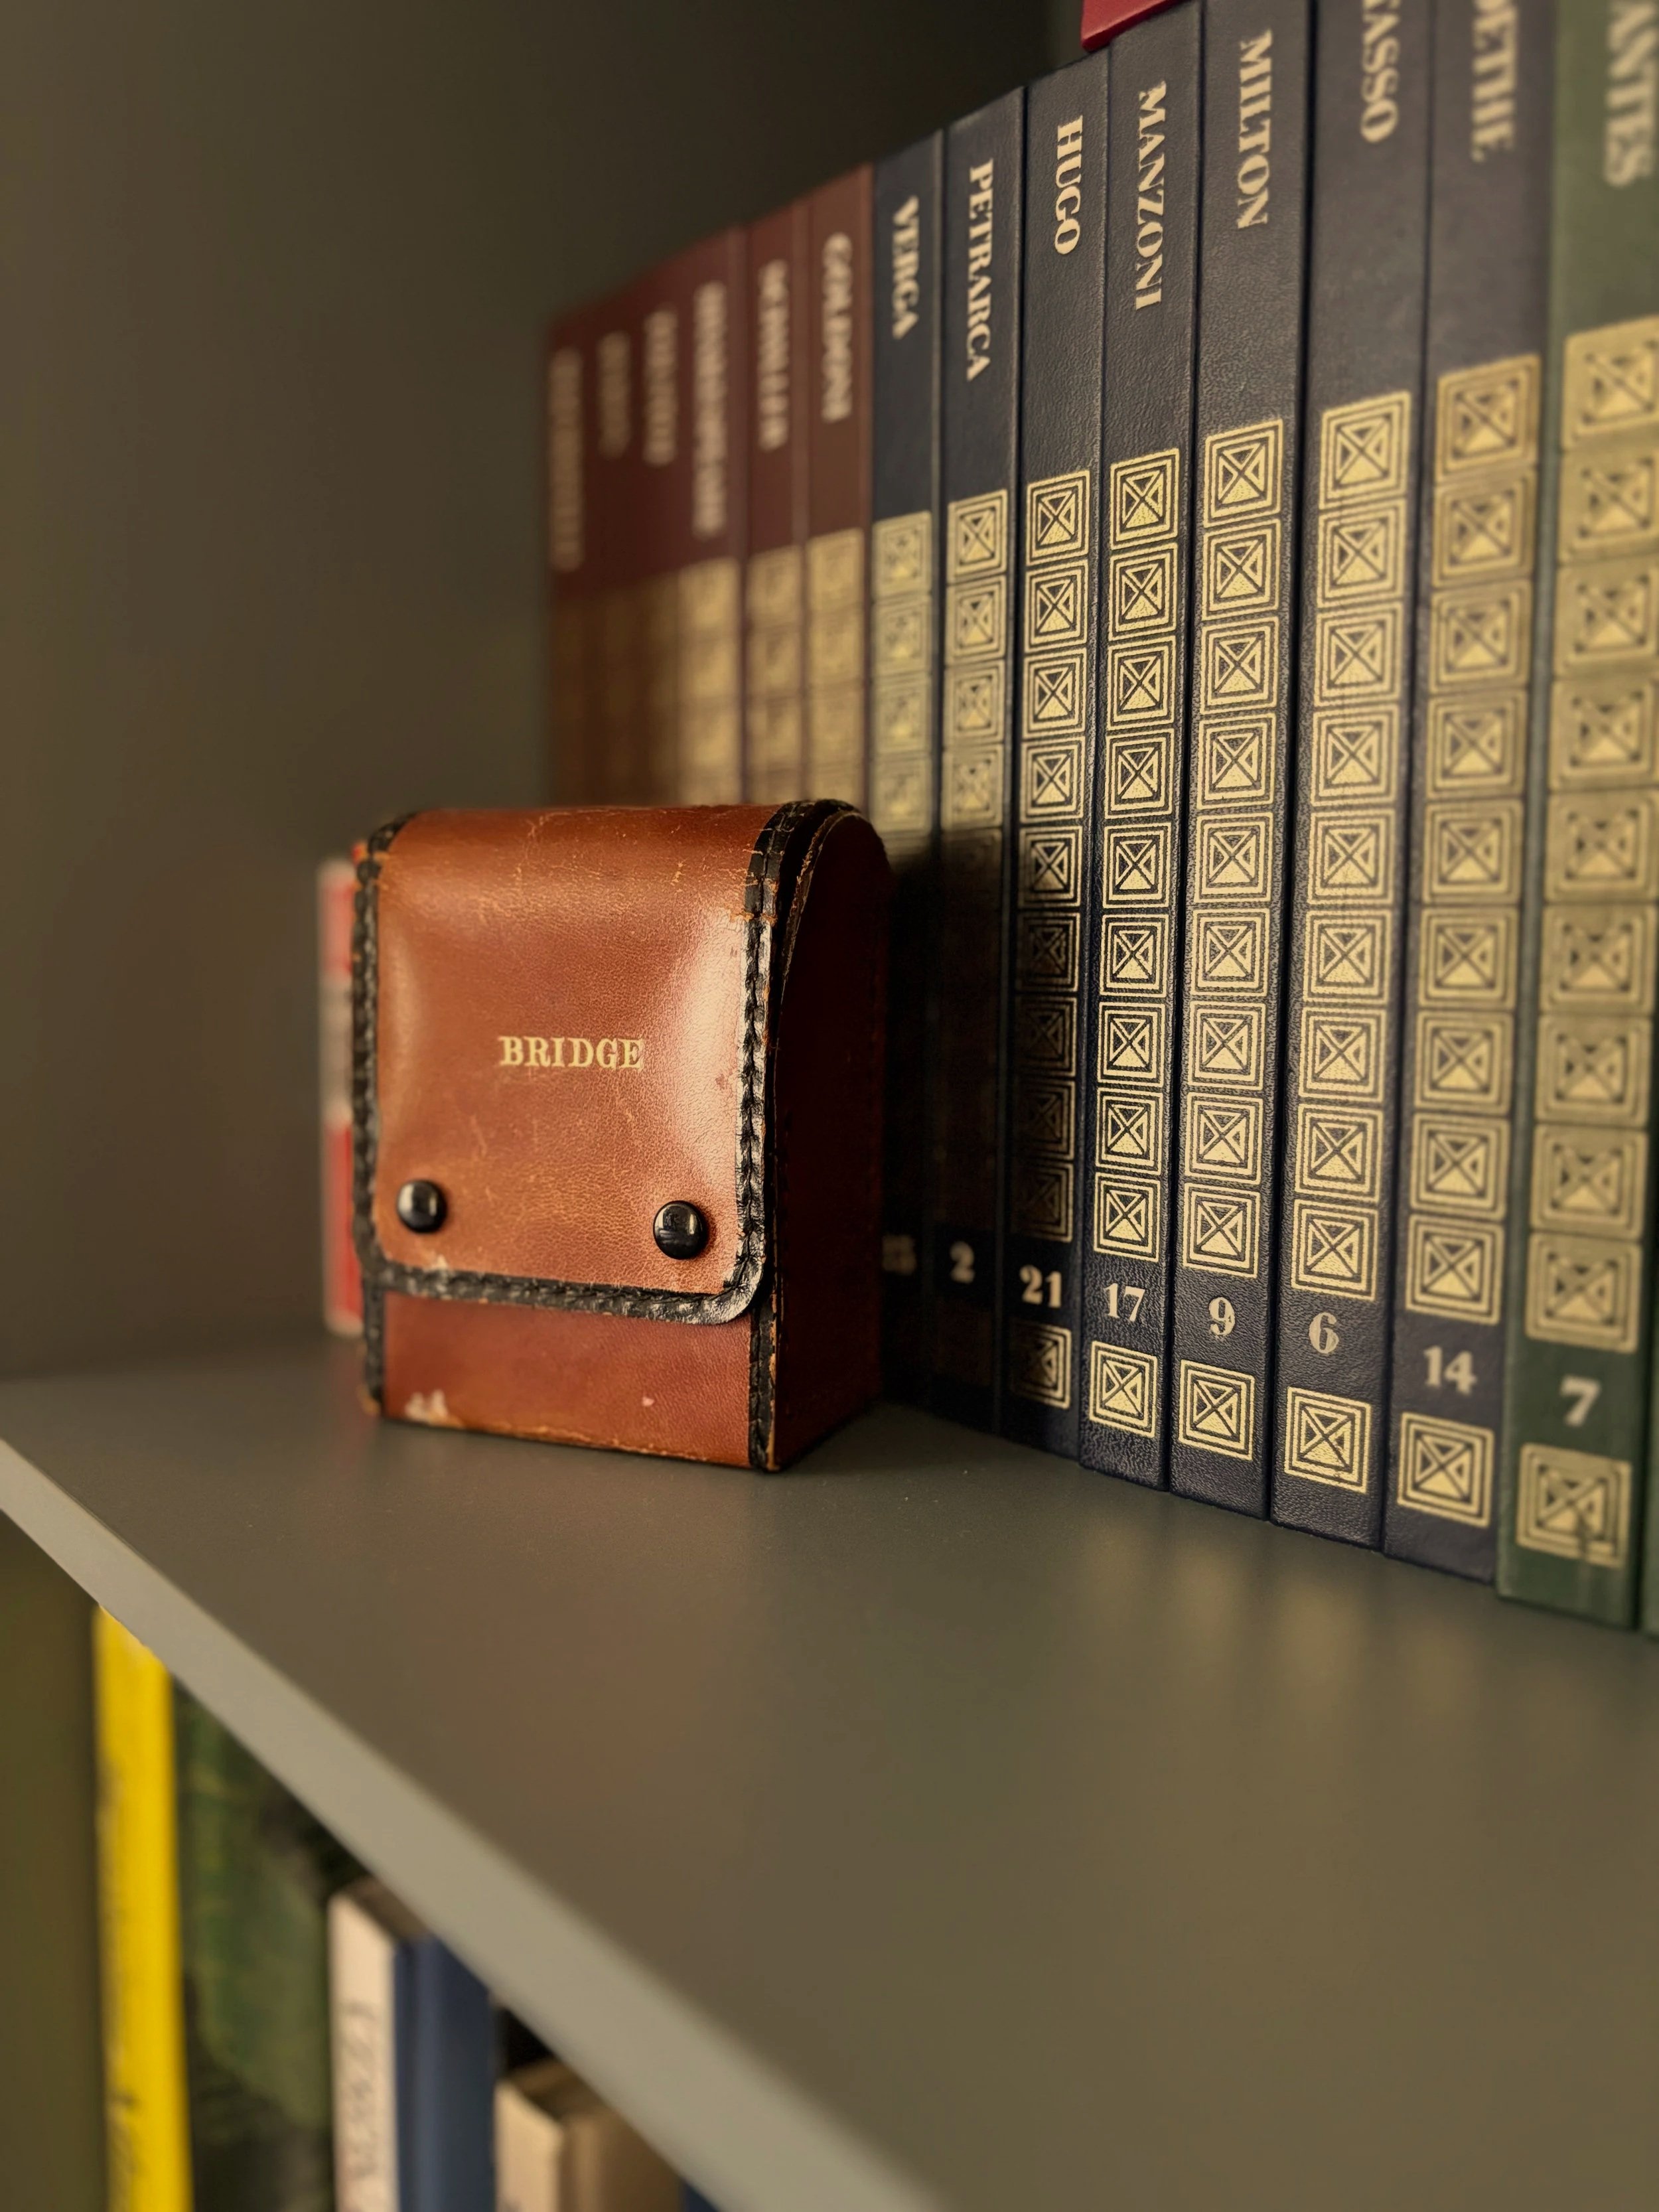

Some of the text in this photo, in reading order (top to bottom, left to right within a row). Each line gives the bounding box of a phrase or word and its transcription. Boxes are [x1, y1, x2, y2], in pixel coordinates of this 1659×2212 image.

[1238, 30, 1272, 228] MILTON
[1054, 115, 1083, 254] HUGO
[1136, 81, 1166, 310] MANZONI
[892, 196, 919, 340] VERGA
[967, 159, 993, 381] PETRARCA
[498, 1036, 644, 1070] BRIDGE
[950, 1242, 974, 1284] 2
[1019, 1265, 1062, 1309] 21
[1103, 1283, 1145, 1322] 17
[1208, 1297, 1236, 1337] 9
[1309, 1312, 1339, 1355] 6
[1424, 1346, 1477, 1394] 14
[1561, 1376, 1601, 1426] 7
